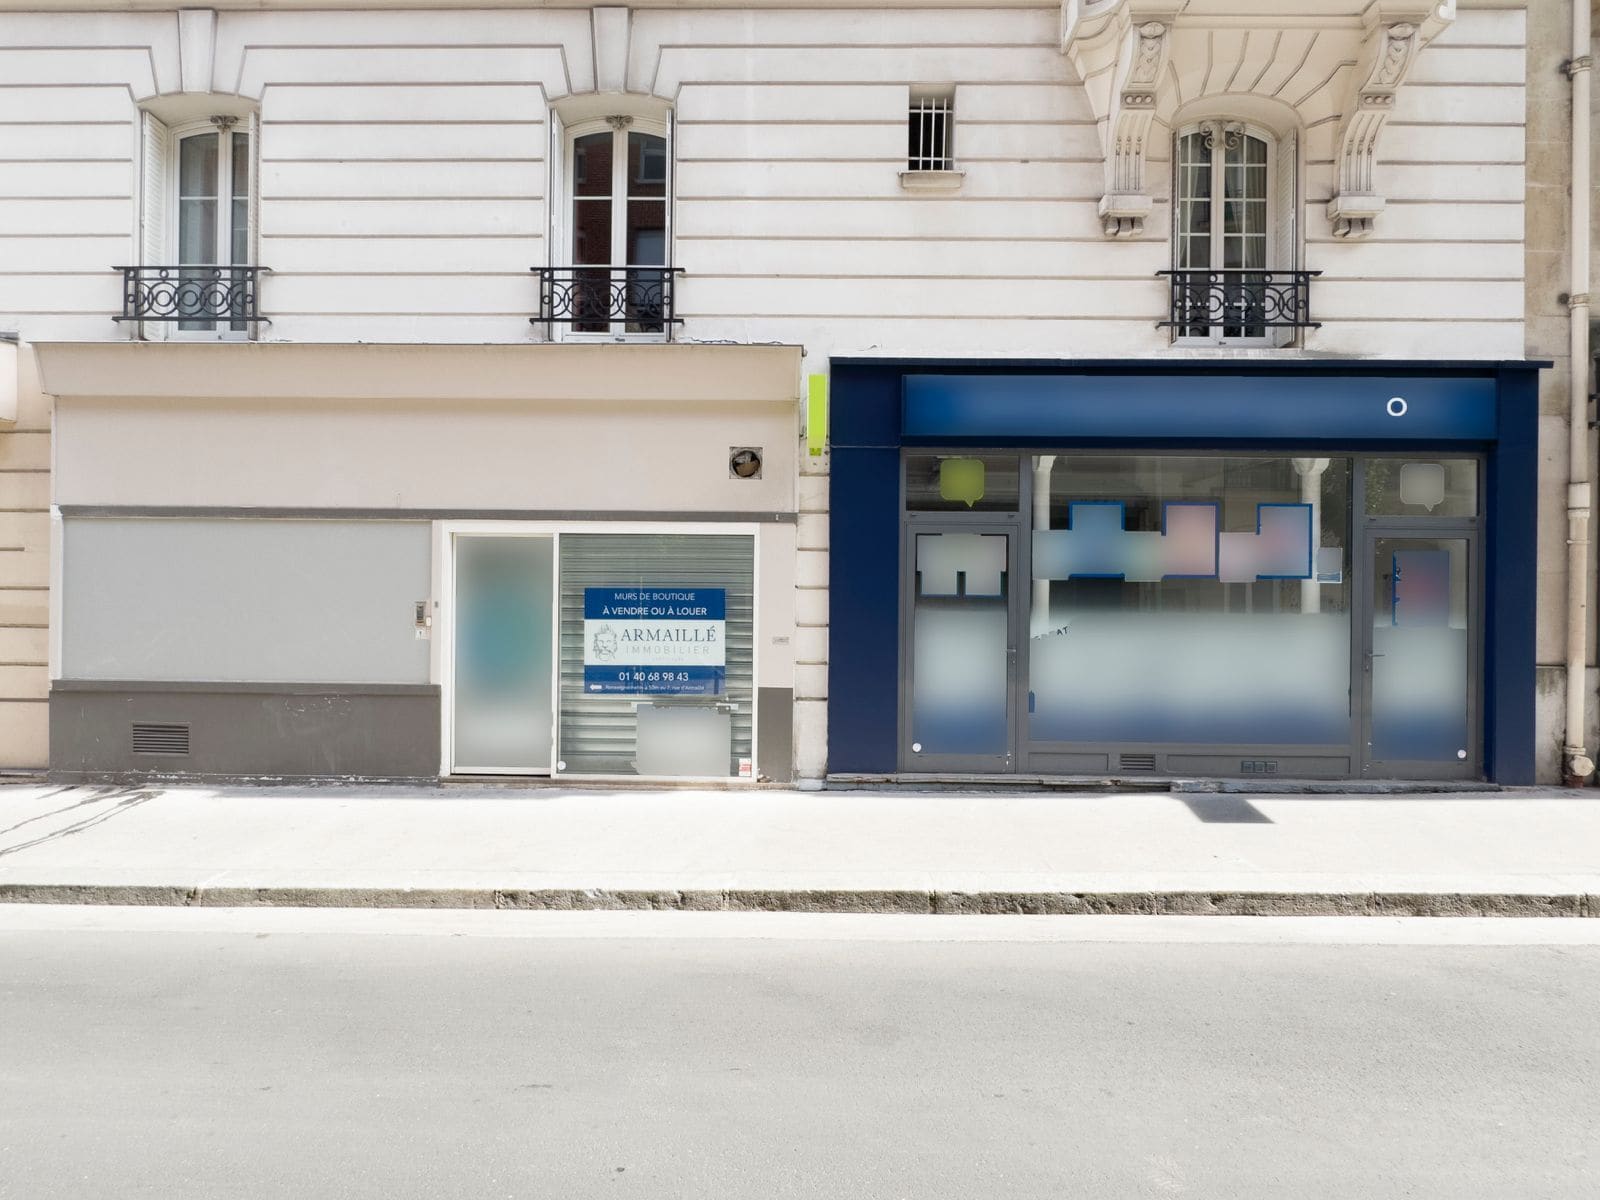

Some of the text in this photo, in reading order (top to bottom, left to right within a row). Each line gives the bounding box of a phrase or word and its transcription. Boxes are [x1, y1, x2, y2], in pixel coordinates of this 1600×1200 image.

[614, 592, 696, 601] MURS DE BOUTIQUE
[602, 605, 708, 616] À VENDRE OU À LOUER
[620, 625, 717, 642] ARMAILLÉ
[625, 644, 710, 655] IMMOBILIER
[618, 671, 689, 682] 01 40 68 98 43
